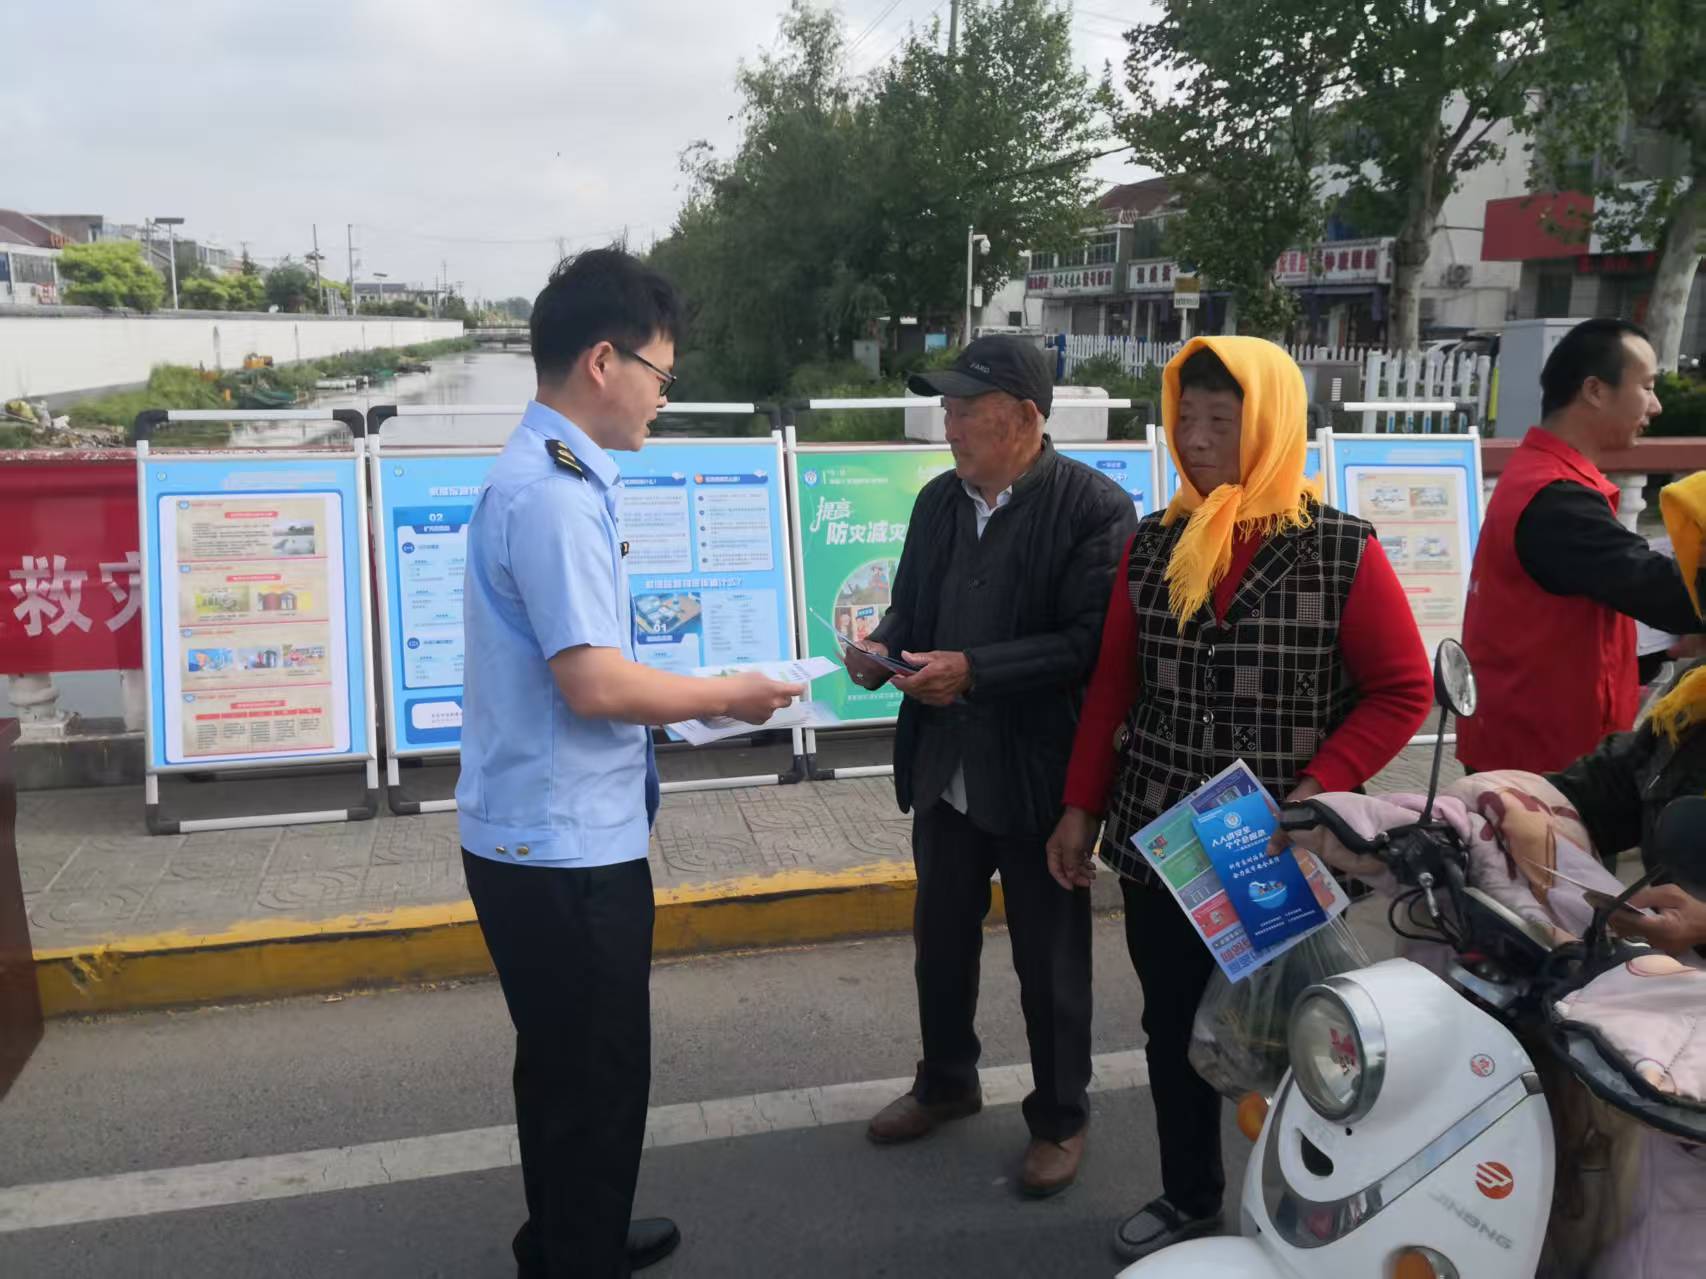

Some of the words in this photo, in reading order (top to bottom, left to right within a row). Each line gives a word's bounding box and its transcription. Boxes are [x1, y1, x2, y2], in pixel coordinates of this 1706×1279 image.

[429, 513, 443, 522] 02
[810, 496, 853, 532] 提高
[653, 623, 667, 633] 01
